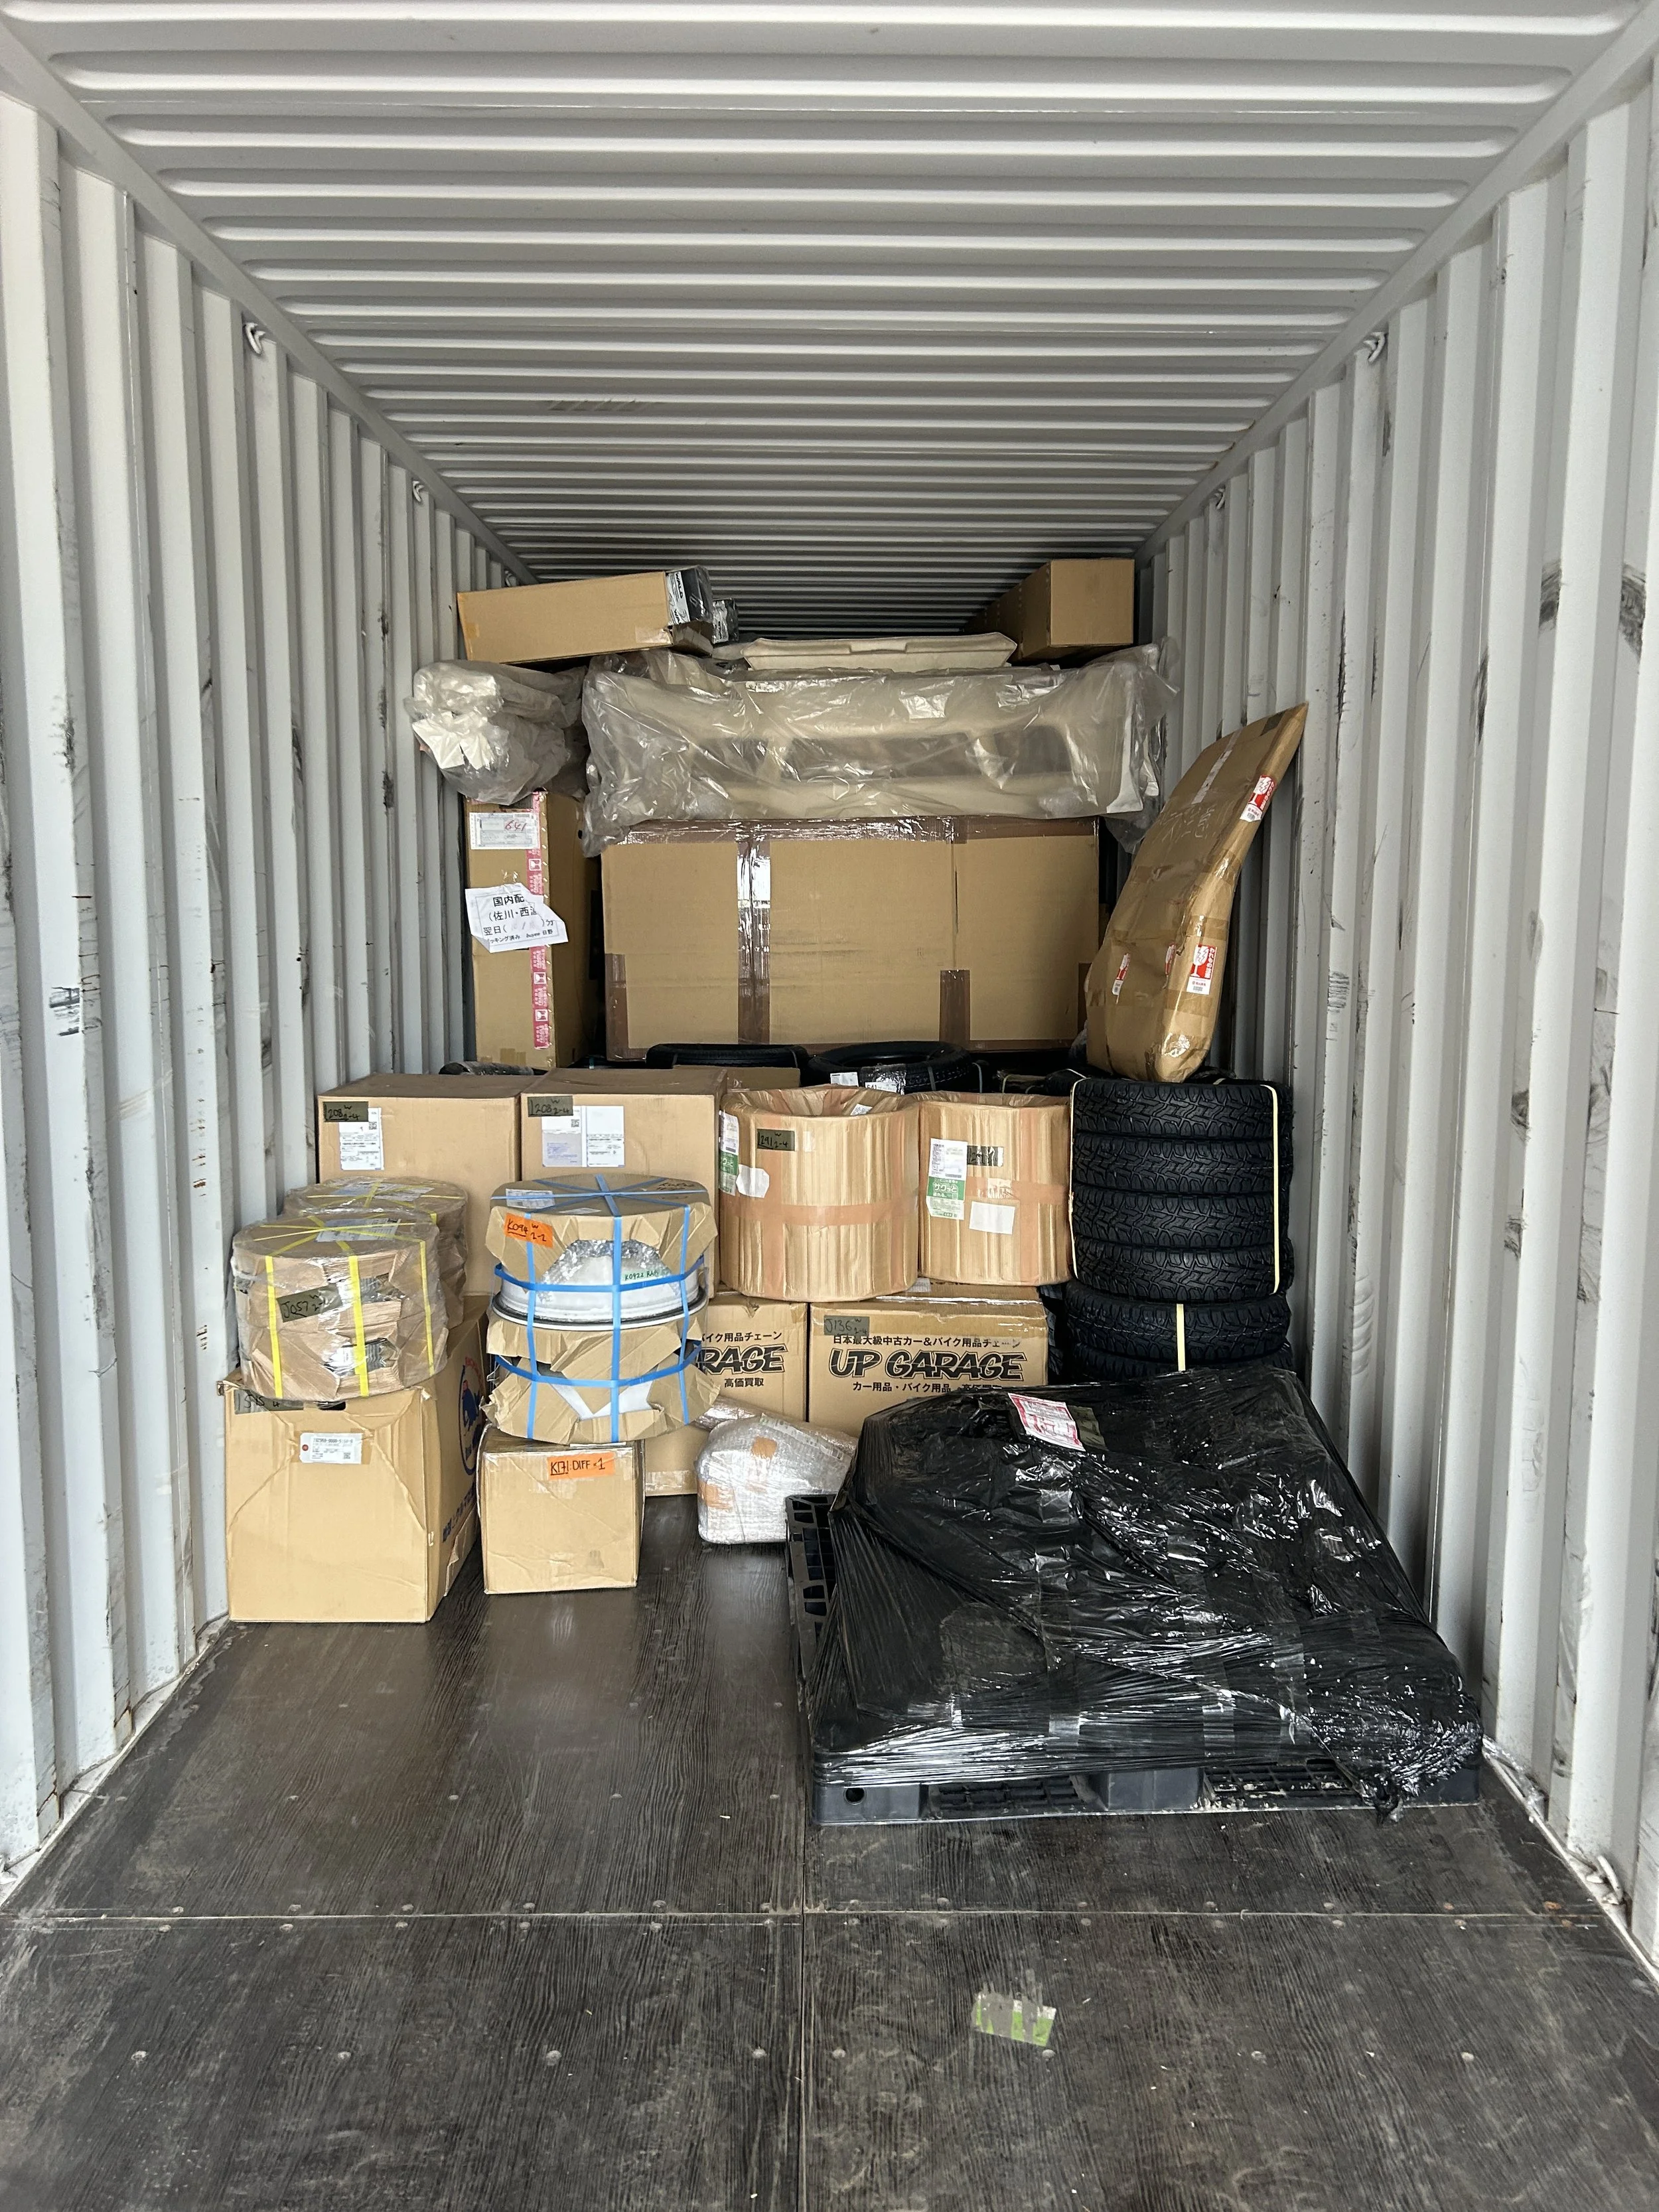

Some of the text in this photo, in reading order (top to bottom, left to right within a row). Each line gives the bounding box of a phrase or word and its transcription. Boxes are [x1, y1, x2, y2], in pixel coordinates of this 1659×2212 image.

[504, 820, 527, 832] 641
[825, 1318, 853, 1333] J136
[829, 1347, 1027, 1382] UP GARAGE
[724, 1377, 764, 1388] 高価買取
[572, 1460, 591, 1471] DIFF
